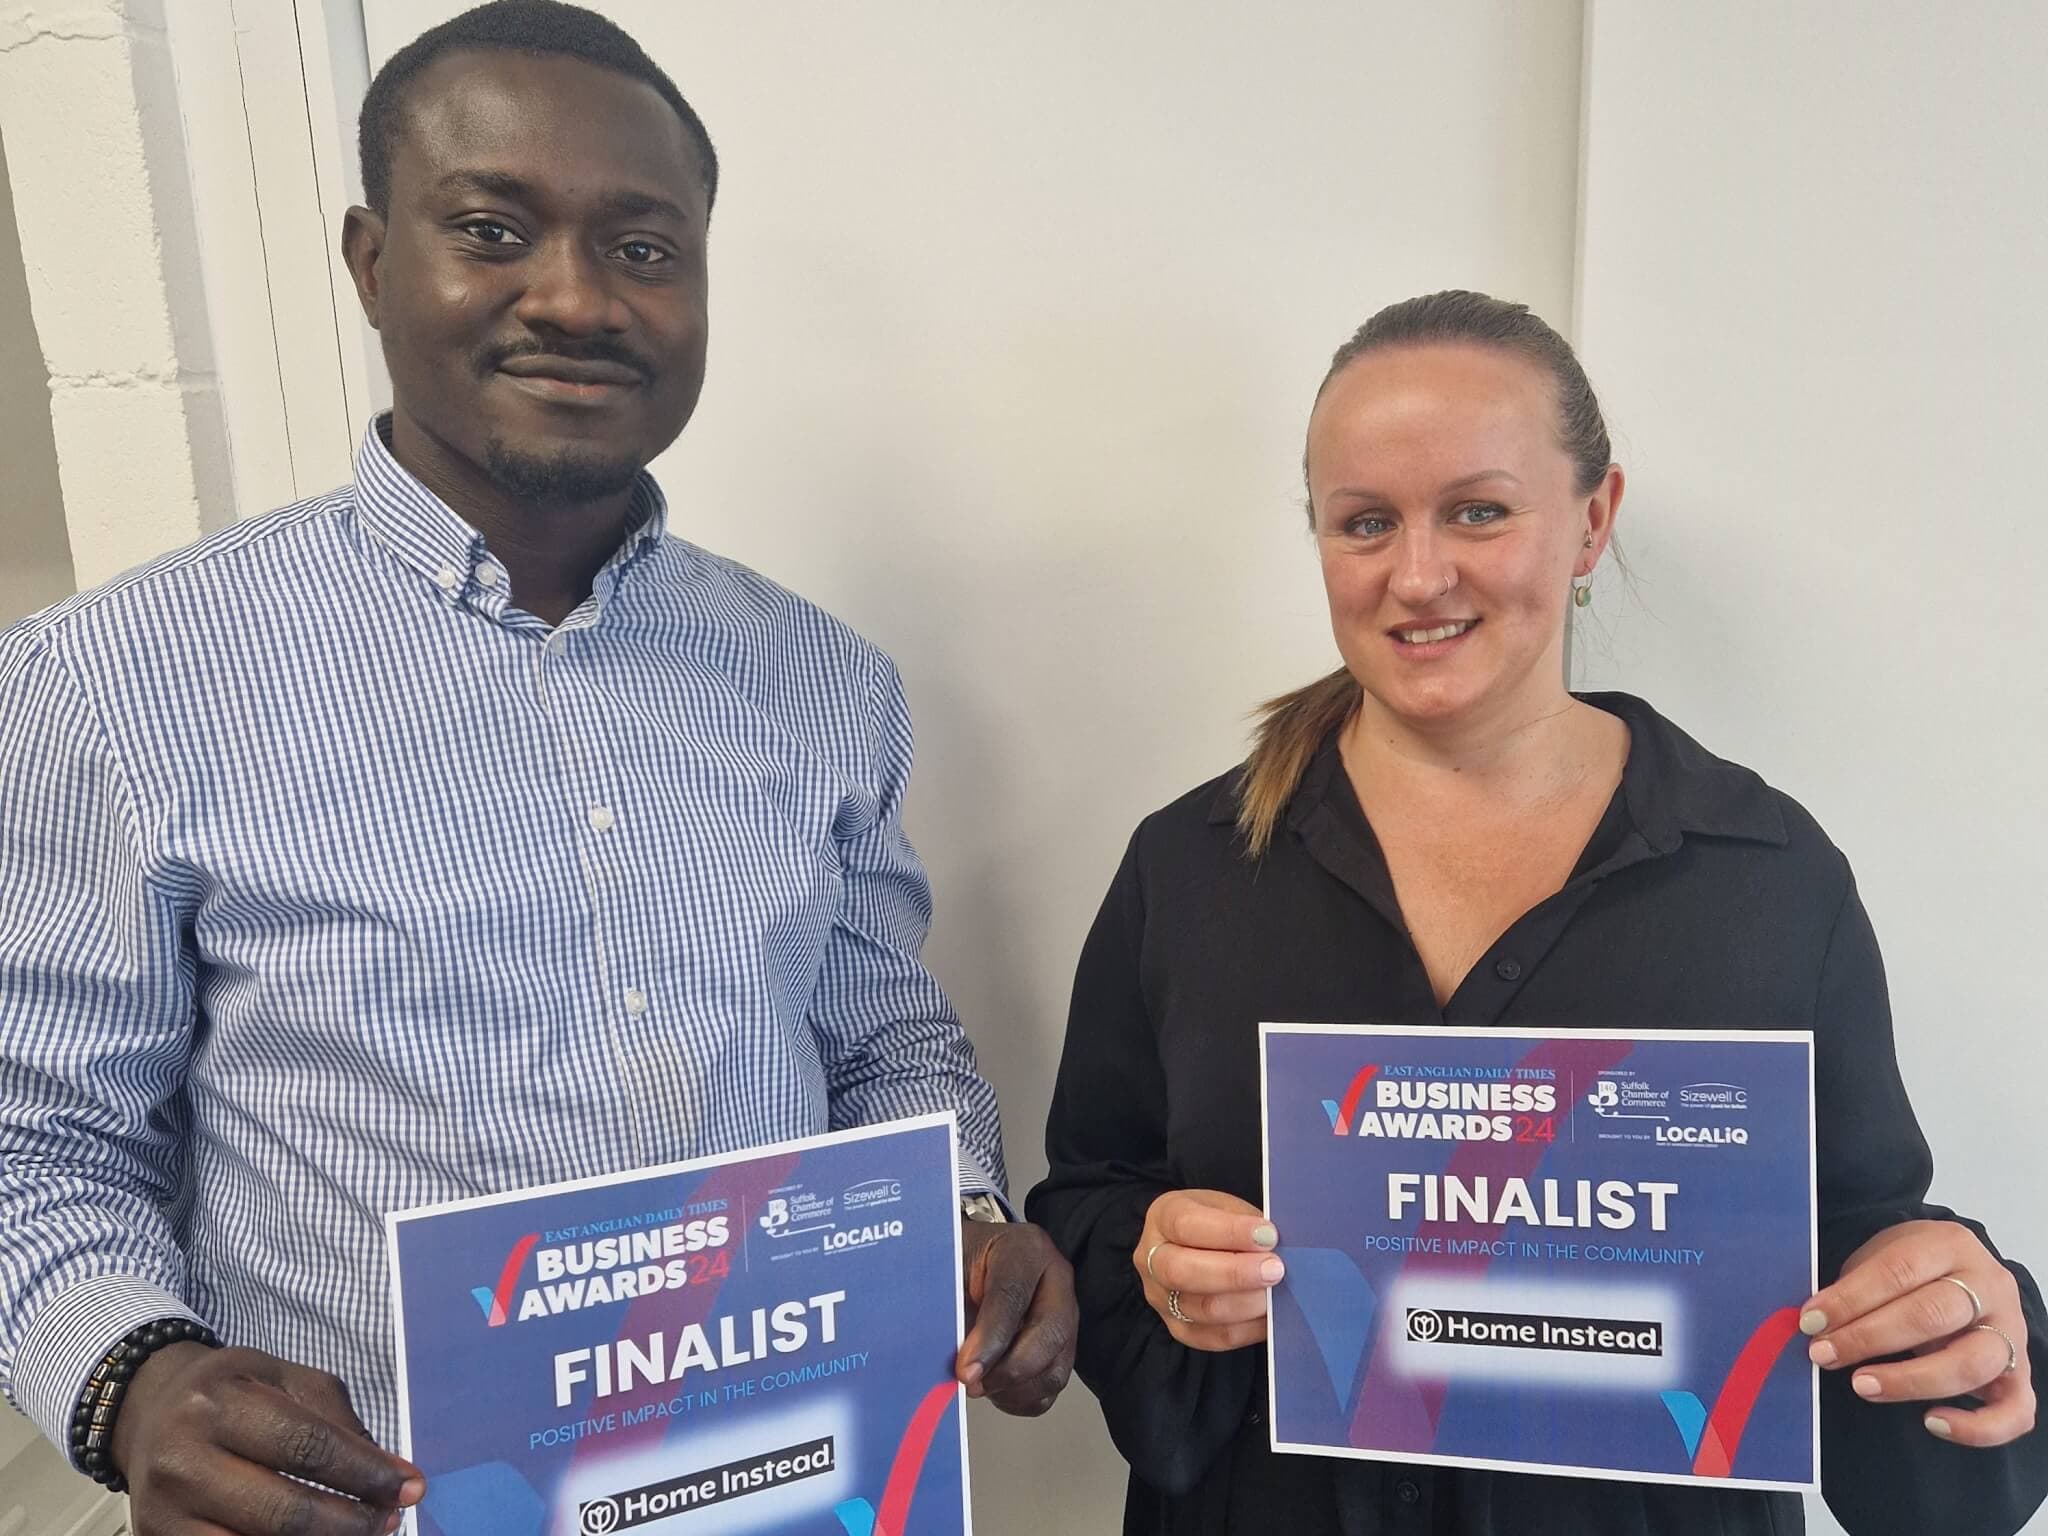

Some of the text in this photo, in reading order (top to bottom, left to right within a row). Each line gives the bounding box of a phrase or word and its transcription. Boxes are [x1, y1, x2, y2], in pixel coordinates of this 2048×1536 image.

[1384, 1065, 1556, 1080] EAST ANGLIAN DAILY TIMES
[1621, 1081, 1650, 1090] Suffolk
[1376, 1080, 1557, 1112] BUSINESS
[1621, 1090, 1669, 1099] Chamber of
[1621, 1098, 1667, 1107] Commerce
[1680, 1090, 1748, 1103] Sizewell C
[843, 1186, 888, 1205] Sizewell
[890, 1182, 901, 1197] C
[1388, 1172, 1679, 1231] FINALIST
[545, 1198, 728, 1243] EAST ANGLIAN DAILY TIMES
[536, 1216, 730, 1282] BUSINESS
[1365, 1235, 1705, 1266] POSITIVE IMPACT IN THE COMMUNITY
[1448, 1316, 1537, 1343] Home
[554, 1290, 846, 1408] FINALIST
[529, 1351, 870, 1450] POSITIVE IMPACT IN THE COMMUNITY
[625, 1476, 717, 1522] Home
